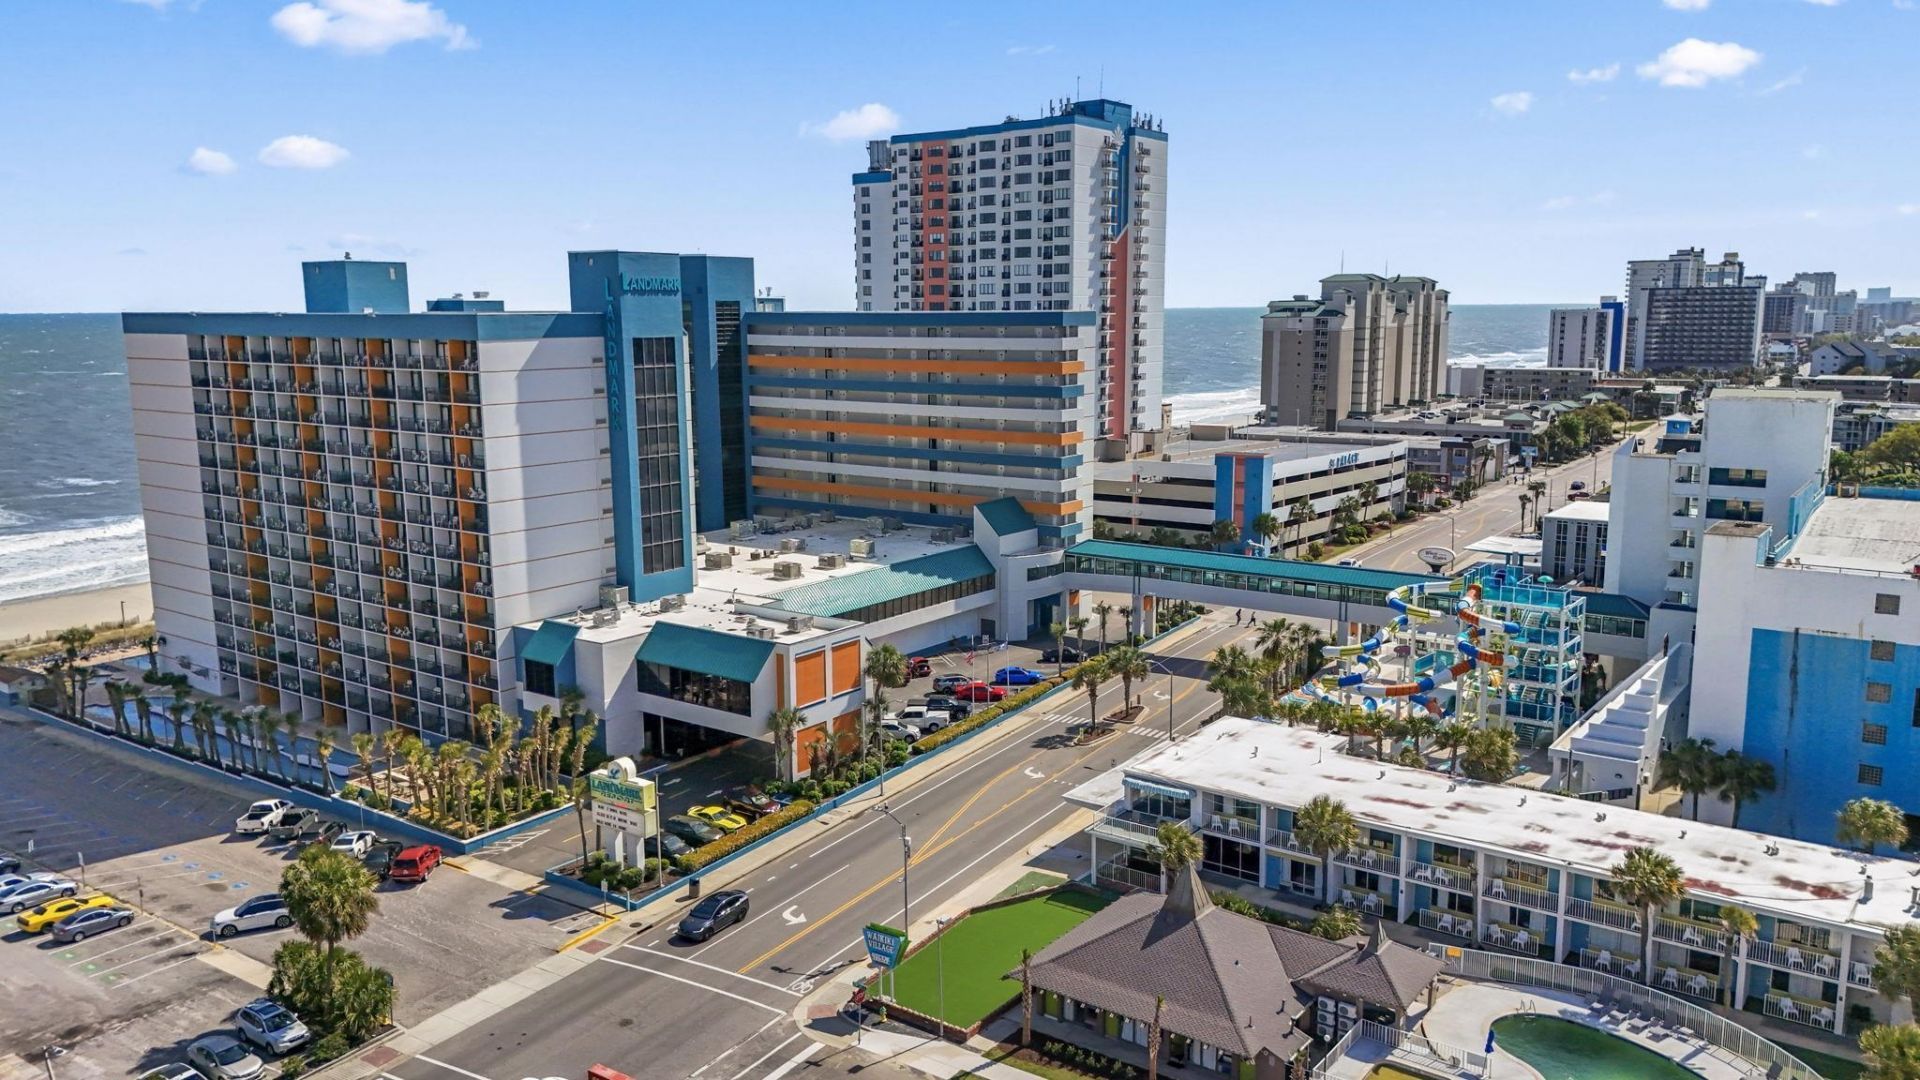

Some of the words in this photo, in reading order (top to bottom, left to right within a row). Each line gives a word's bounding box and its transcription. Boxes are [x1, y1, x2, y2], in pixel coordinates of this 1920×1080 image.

[621, 271, 681, 291] LANDMARK
[604, 277, 621, 431] LANDMARK
[866, 931, 895, 946] WAIKIKI
[868, 940, 896, 954] VILLAGE
